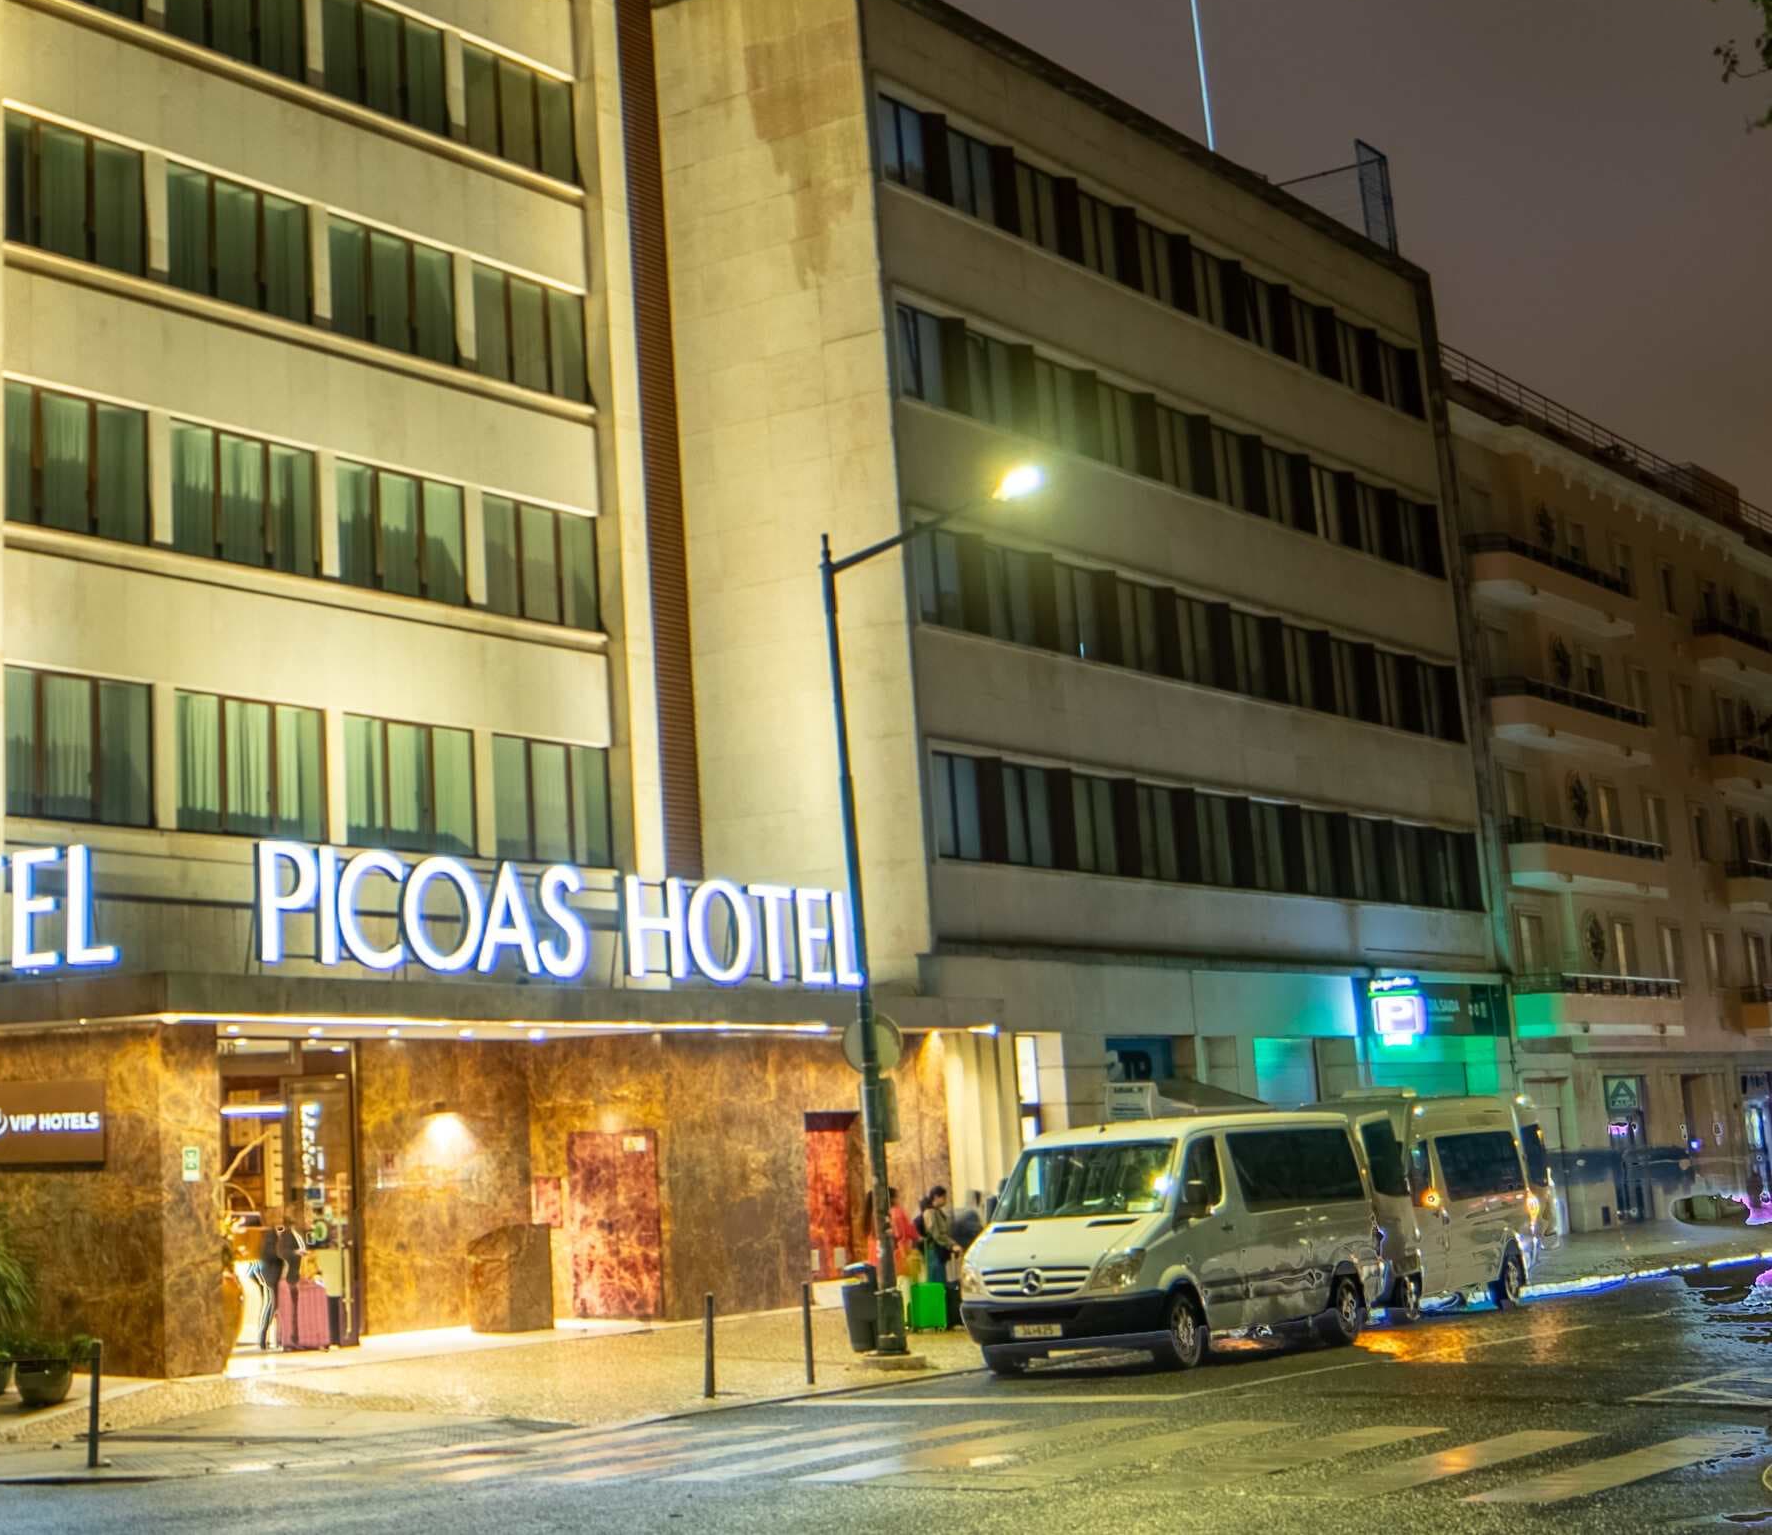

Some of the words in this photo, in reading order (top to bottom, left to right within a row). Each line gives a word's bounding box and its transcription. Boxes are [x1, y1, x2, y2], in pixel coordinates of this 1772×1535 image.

[255, 840, 590, 979] PICOAS
[624, 874, 865, 989] HOTEL
[1378, 1000, 1413, 1031] P
[9, 1113, 37, 1132] VIP
[38, 1111, 100, 1131] HOTELS
